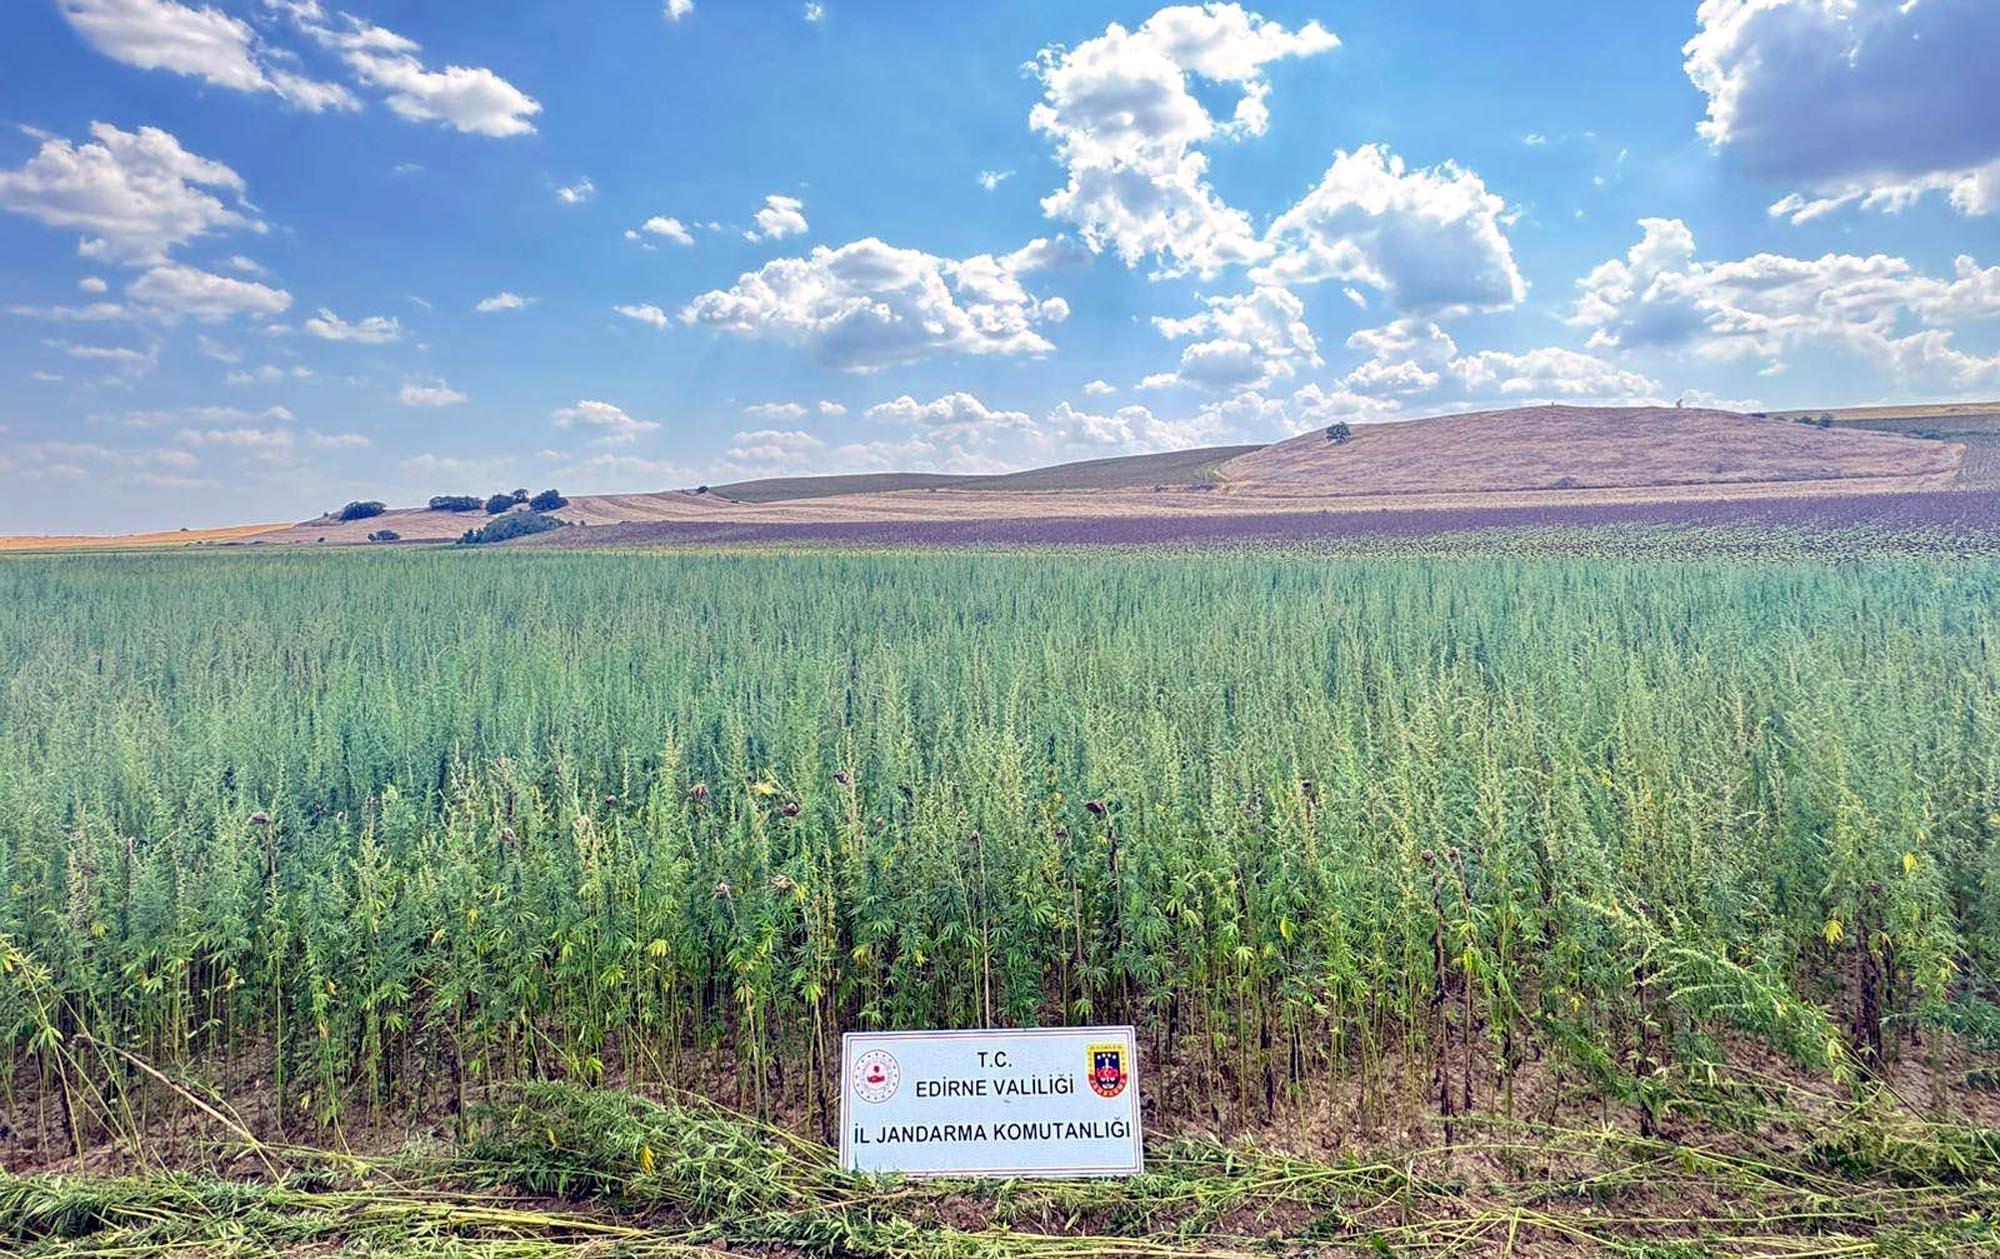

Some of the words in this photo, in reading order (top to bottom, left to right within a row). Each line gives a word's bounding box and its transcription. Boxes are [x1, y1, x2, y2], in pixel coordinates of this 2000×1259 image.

[977, 1051, 1012, 1068] T.C.
[916, 1076, 987, 1097] EDİRNE
[993, 1073, 1074, 1095] VALİLİĞİ
[854, 1123, 870, 1144] İL
[877, 1125, 986, 1143] JANDARMA
[994, 1117, 1130, 1140] KOMUTANLIĞI
